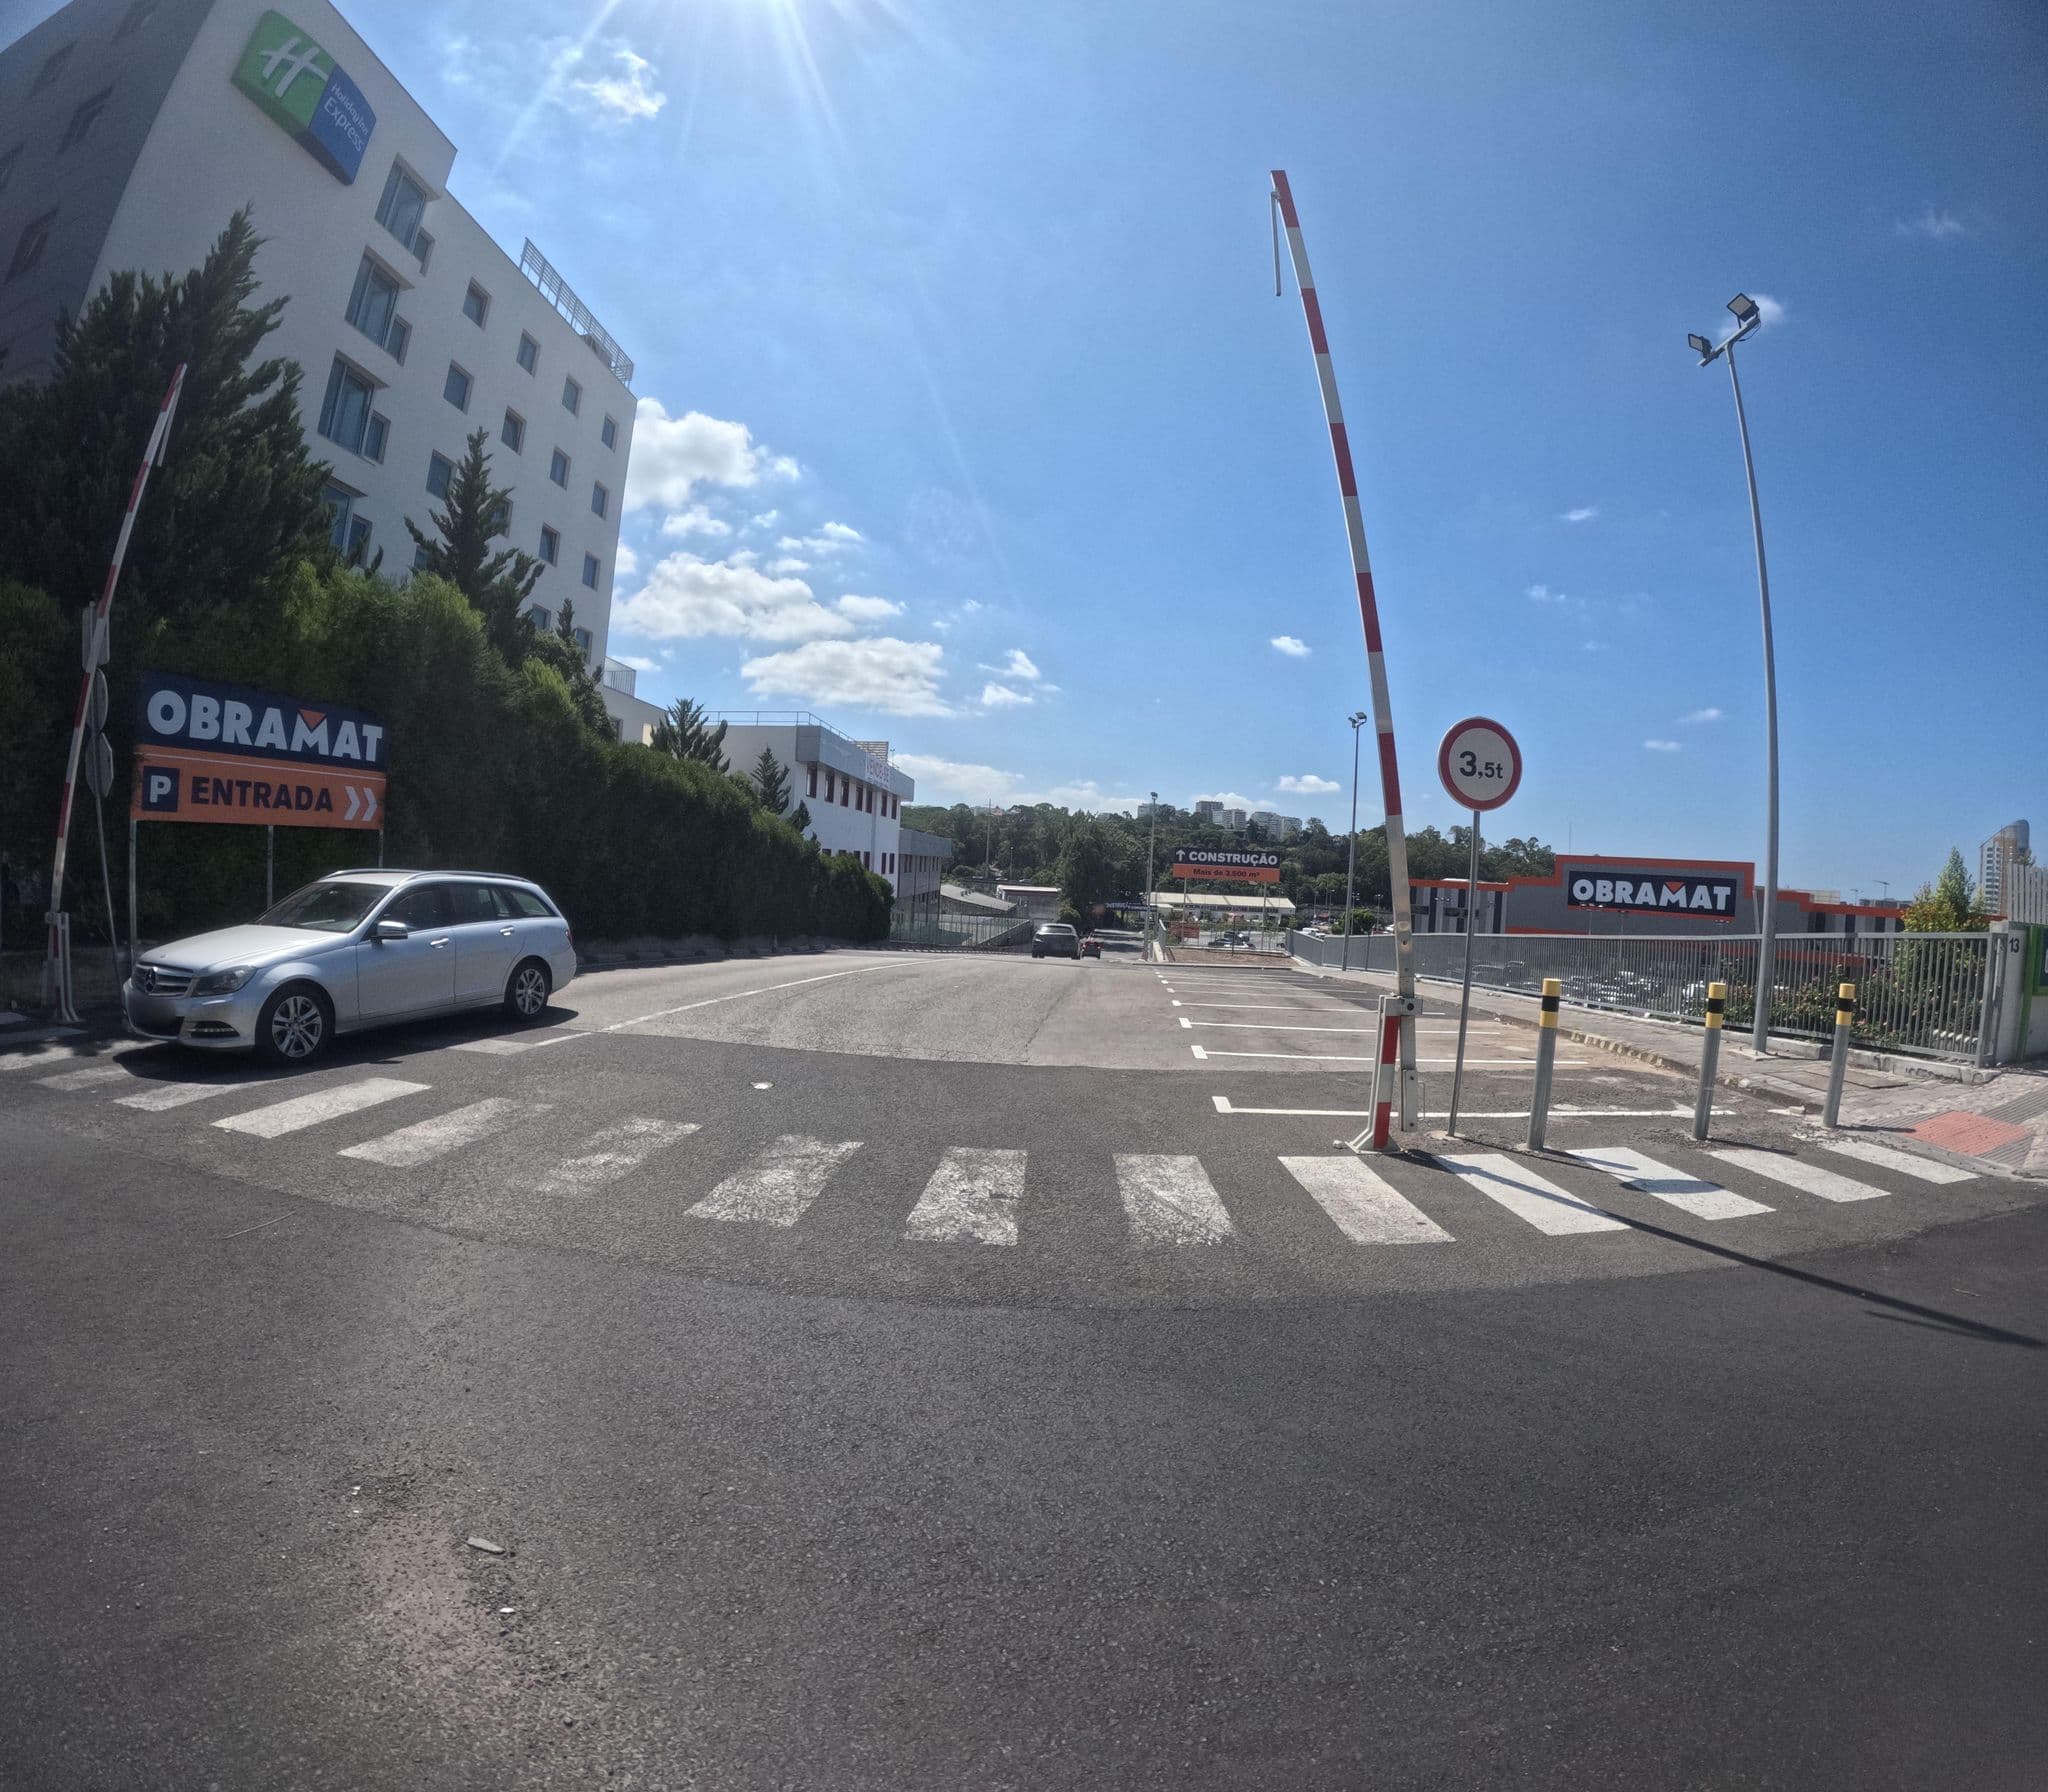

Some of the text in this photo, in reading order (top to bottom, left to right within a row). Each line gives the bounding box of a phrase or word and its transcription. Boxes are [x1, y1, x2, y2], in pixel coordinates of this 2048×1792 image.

[323, 96, 364, 151] Express
[147, 690, 383, 762] OBRAMAT
[1460, 750, 1503, 779] 3,5t
[150, 775, 333, 812] P ENTRADA
[1189, 851, 1278, 867] CONSTRUÇÃO
[1193, 868, 1211, 876] Mais
[1572, 879, 1731, 911] OBRAMAT
[2009, 937, 2020, 953] 13
